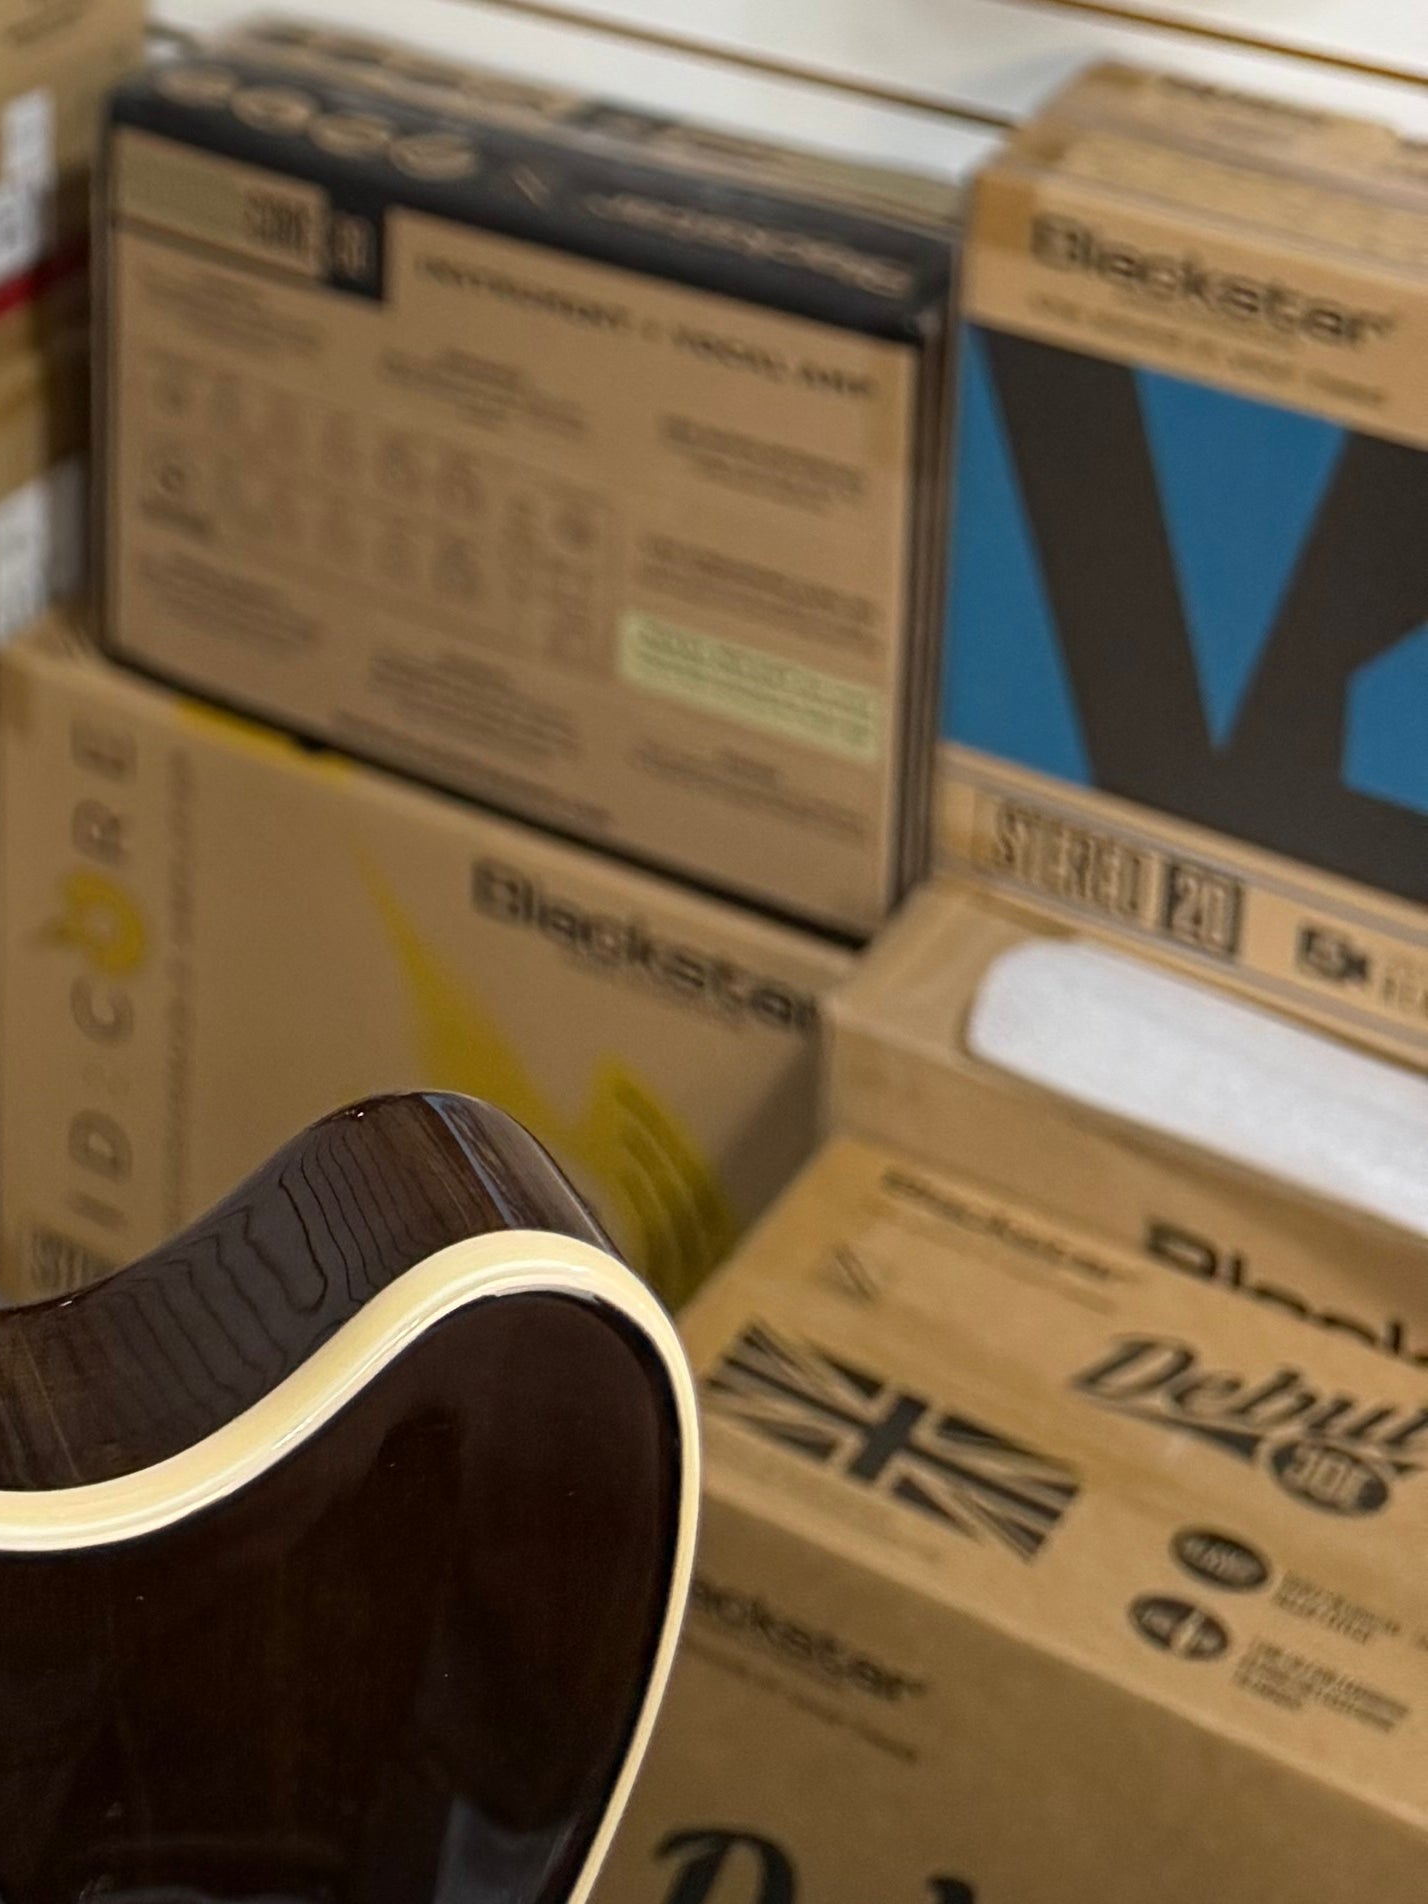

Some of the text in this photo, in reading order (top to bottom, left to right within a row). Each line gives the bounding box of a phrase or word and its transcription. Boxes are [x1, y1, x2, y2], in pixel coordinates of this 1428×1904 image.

[1030, 210, 1394, 352] Blackstar
[992, 798, 1146, 920] STEREO
[690, 1574, 930, 1702] ackstar
